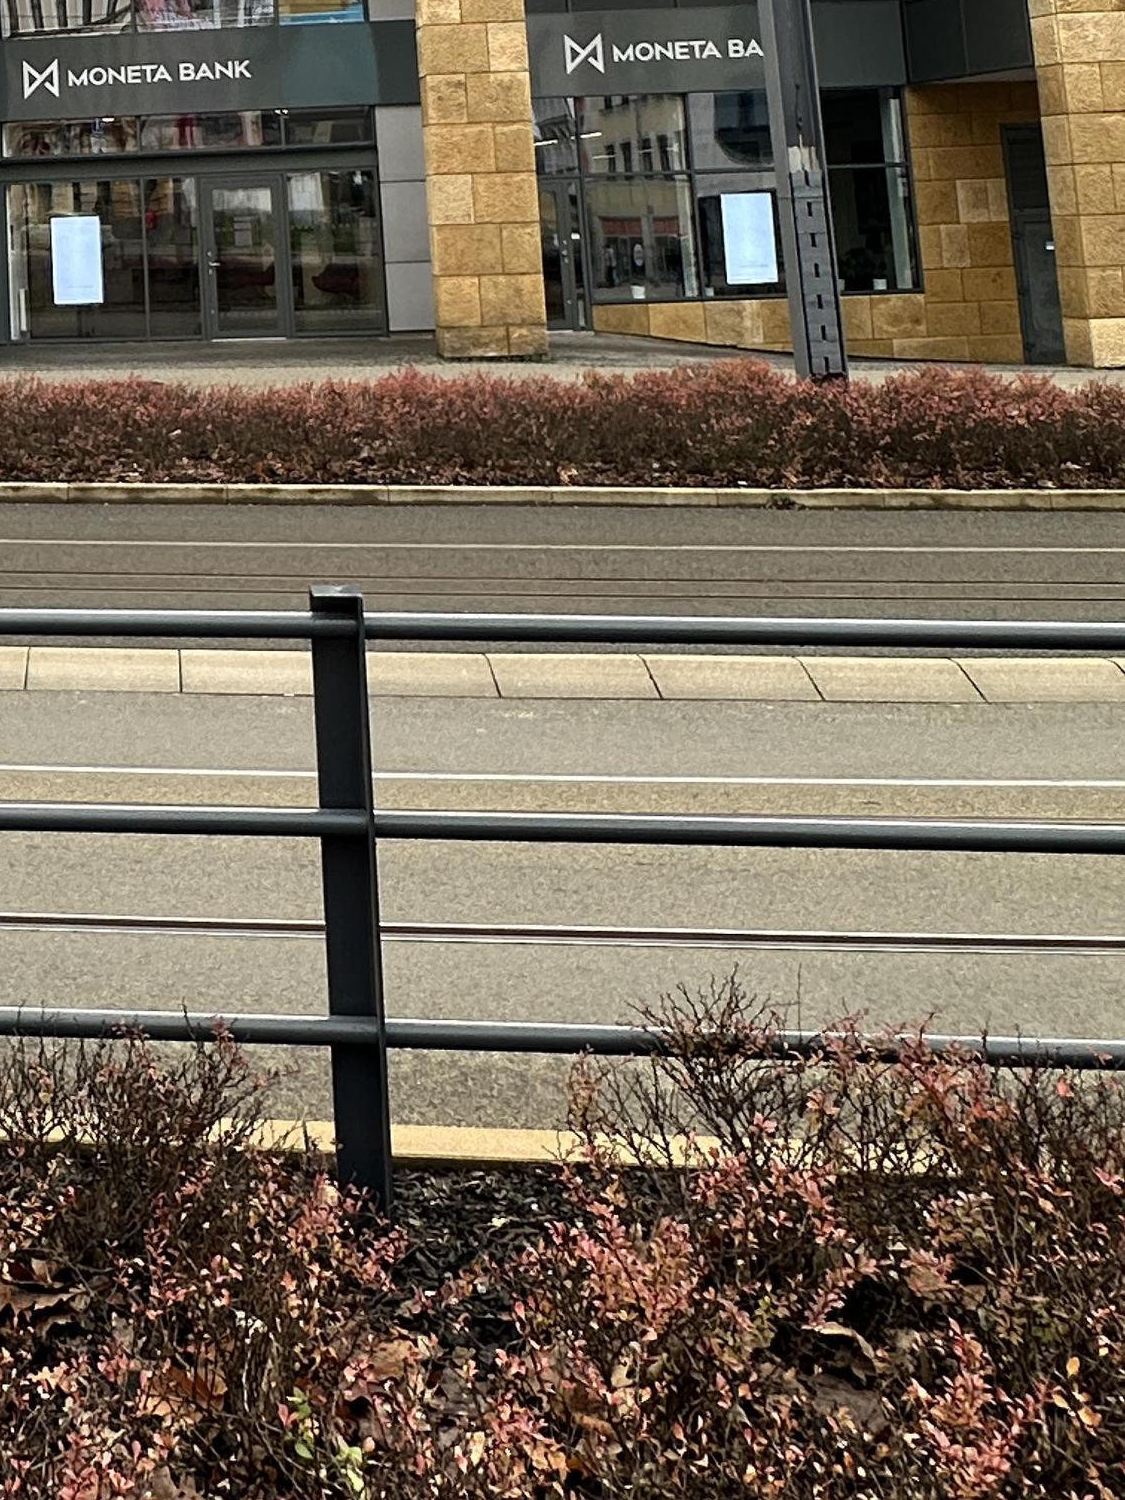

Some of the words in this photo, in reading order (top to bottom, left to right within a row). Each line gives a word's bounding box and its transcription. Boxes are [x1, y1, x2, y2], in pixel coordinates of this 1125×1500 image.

[612, 40, 723, 63] MONETA
[727, 38, 765, 59] BA
[68, 64, 173, 87] MONETA
[178, 59, 252, 82] BANK
